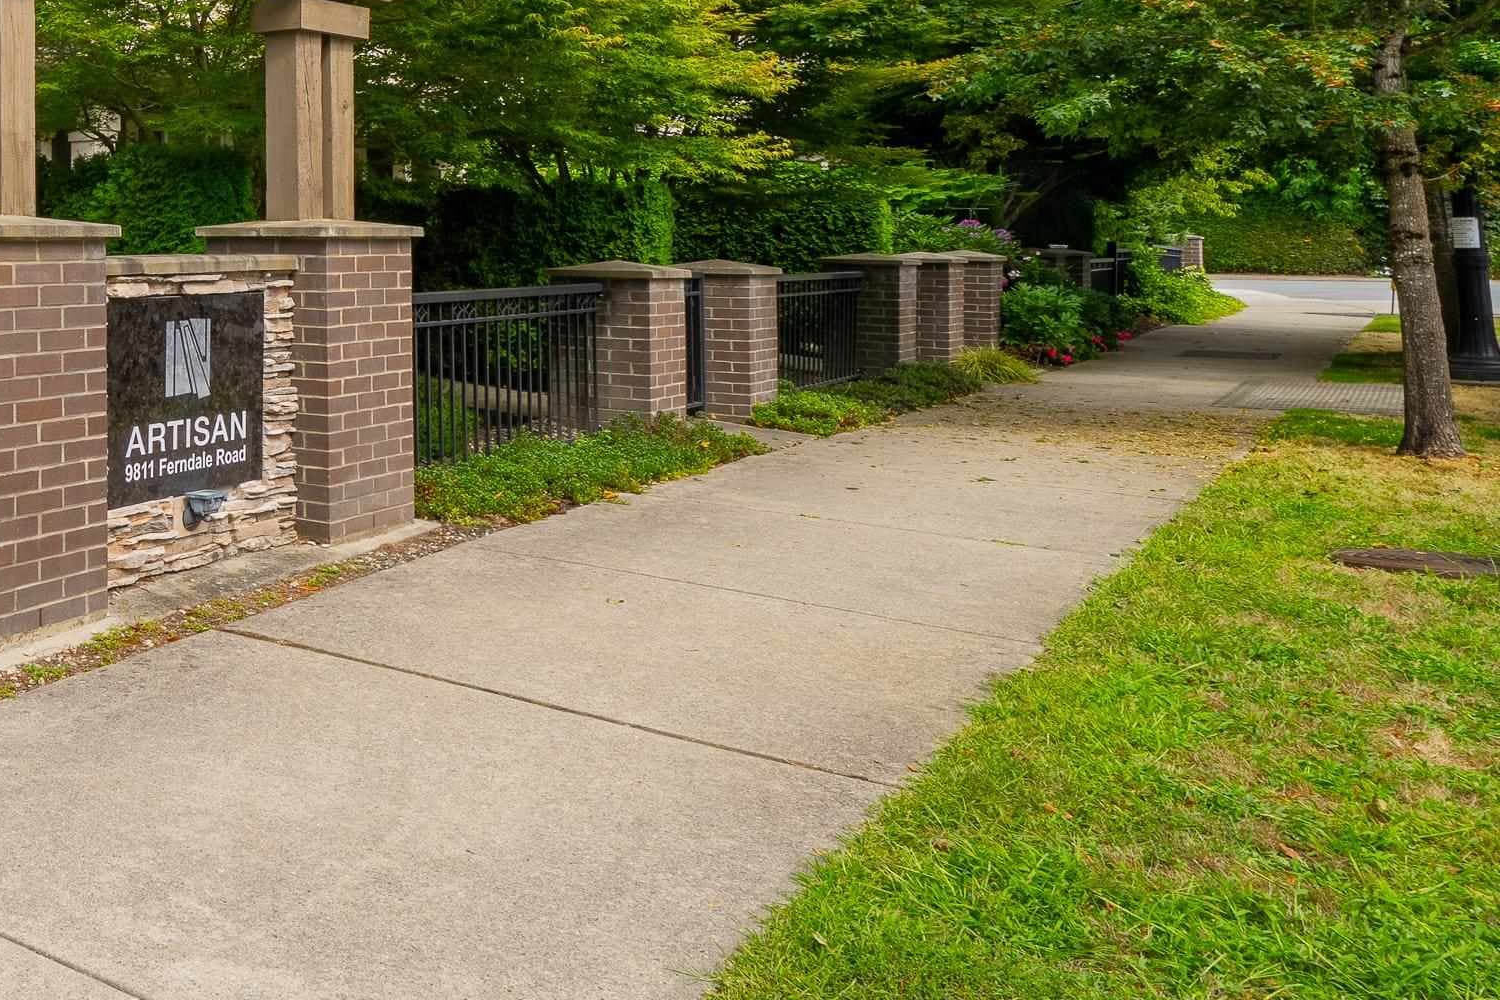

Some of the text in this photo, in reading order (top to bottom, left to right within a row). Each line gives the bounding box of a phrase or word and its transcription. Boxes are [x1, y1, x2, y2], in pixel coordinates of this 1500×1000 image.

[125, 410, 247, 458] ARTISAN
[125, 444, 247, 483] 9811 Ferndale Road
